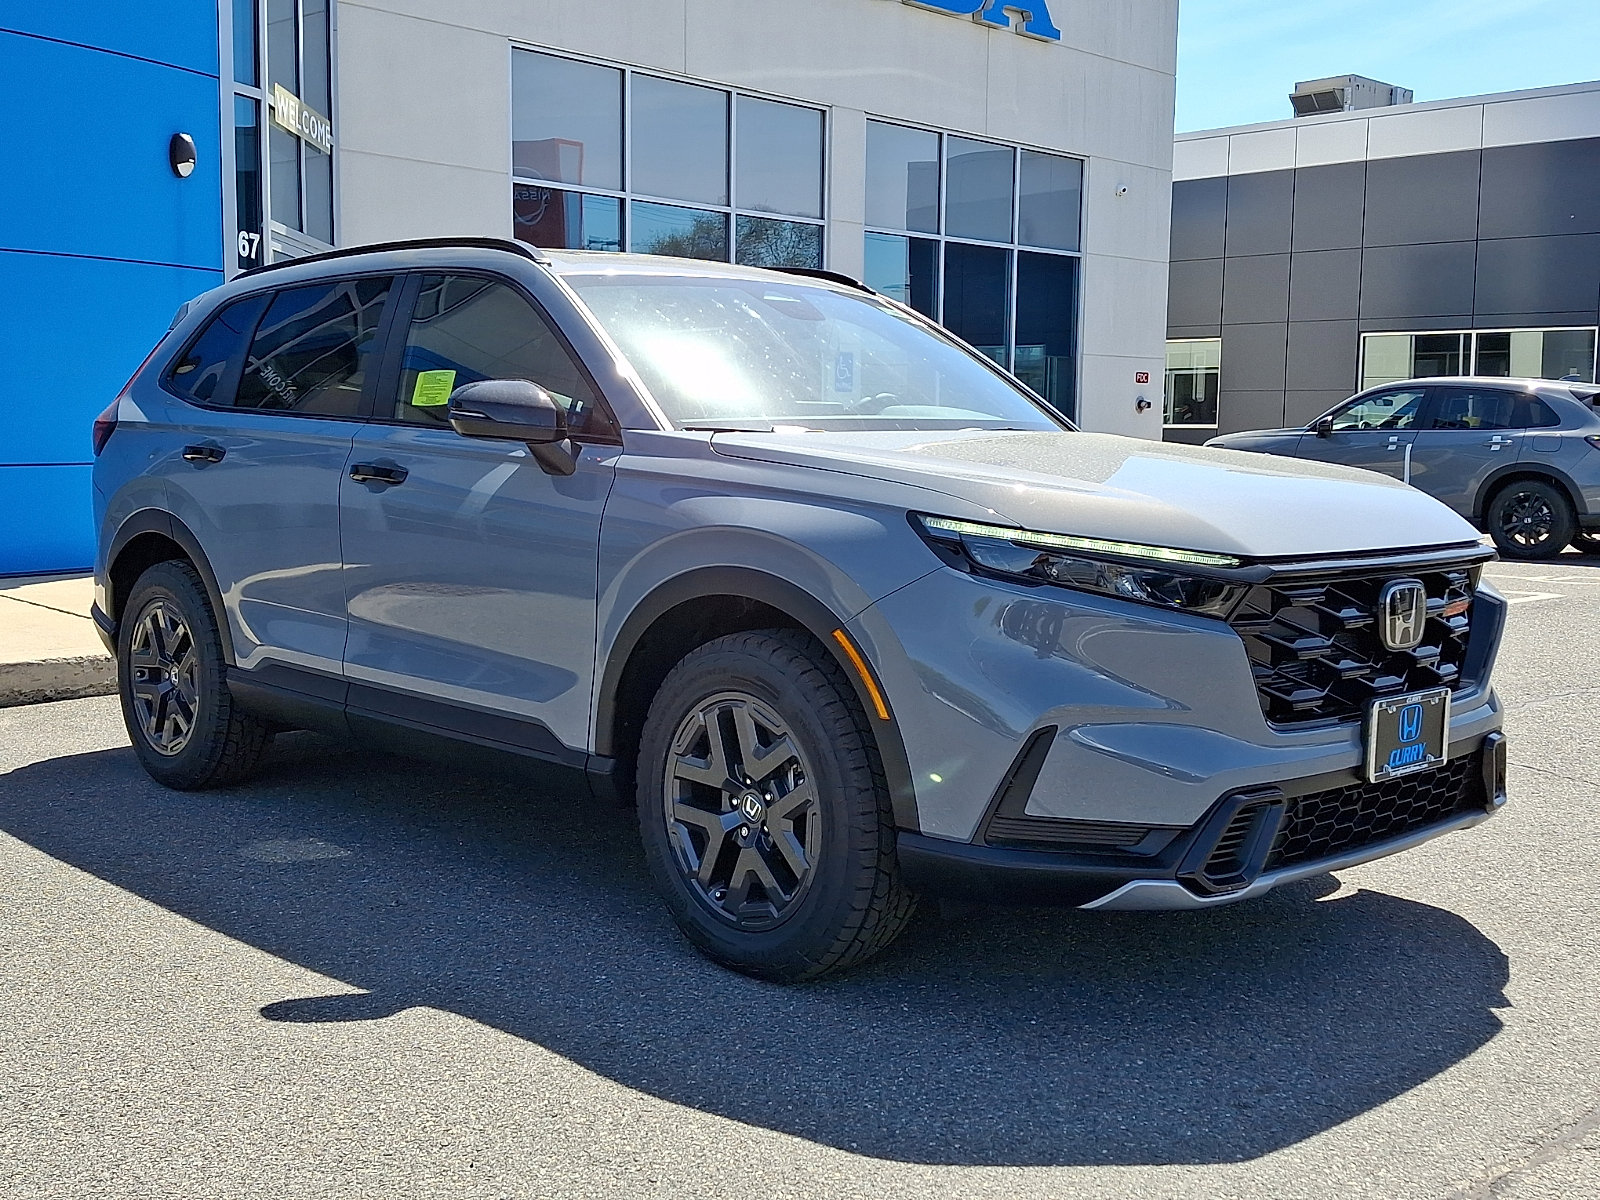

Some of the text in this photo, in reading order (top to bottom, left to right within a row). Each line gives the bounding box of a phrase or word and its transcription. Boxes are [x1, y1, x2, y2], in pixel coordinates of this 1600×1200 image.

[276, 93, 331, 148] WELCOME
[238, 231, 260, 260] 67
[1136, 373, 1148, 382] FDC
[1389, 742, 1427, 767] CURRY
